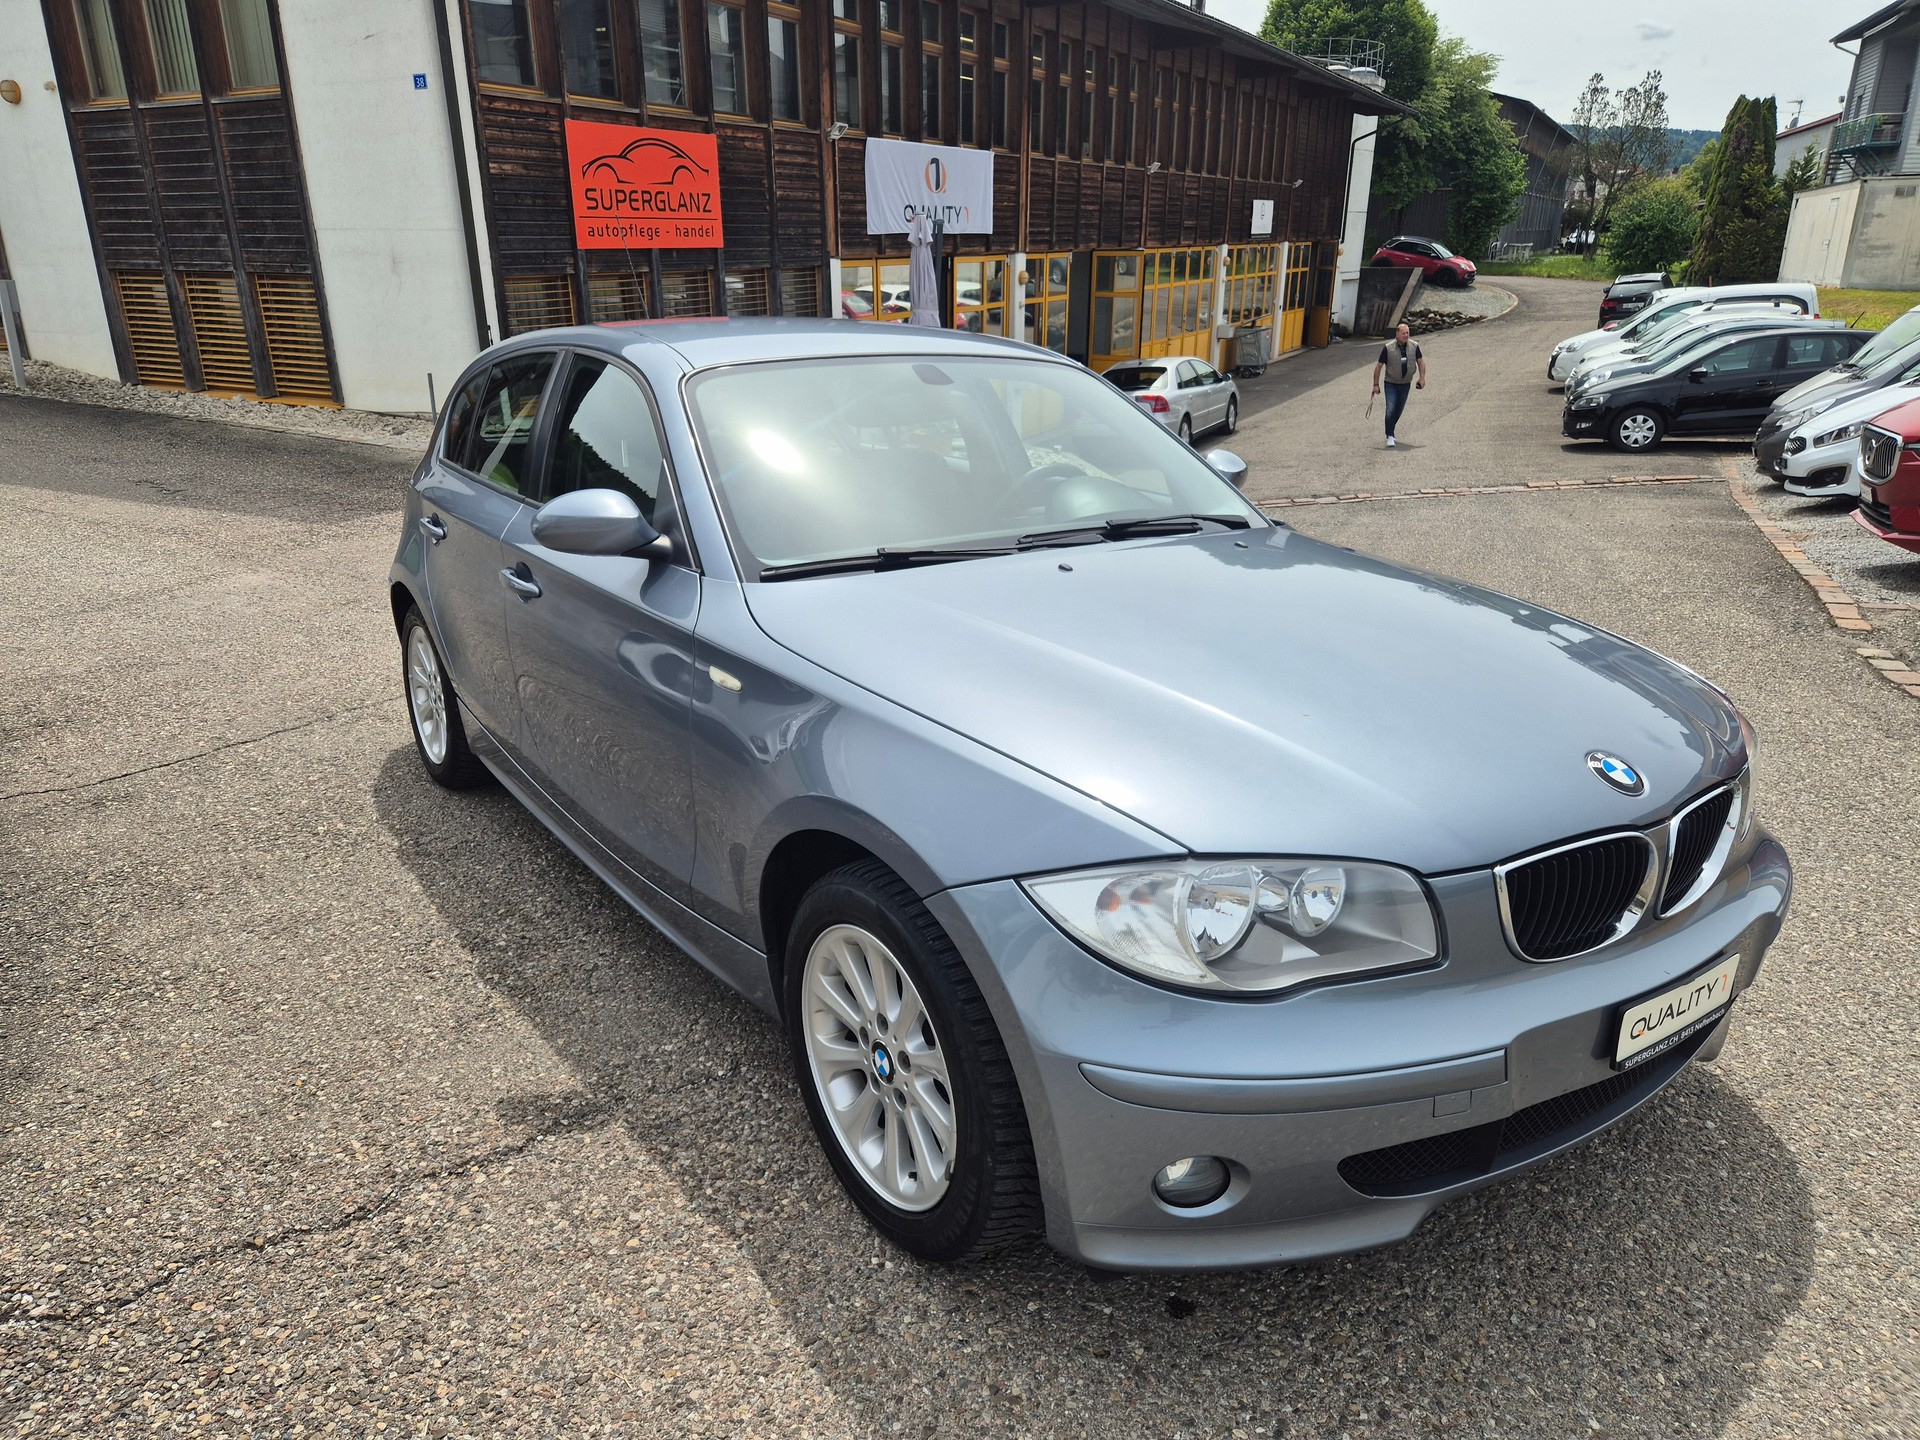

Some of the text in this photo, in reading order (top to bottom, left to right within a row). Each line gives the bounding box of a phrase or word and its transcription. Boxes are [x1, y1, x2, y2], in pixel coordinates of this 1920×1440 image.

[415, 77, 425, 88] 38
[584, 187, 712, 213] SUPERGLANZ
[587, 223, 661, 241] autopflege
[675, 224, 715, 238] handel
[1624, 1035, 1679, 1069] SUPERGLANZ.CH
